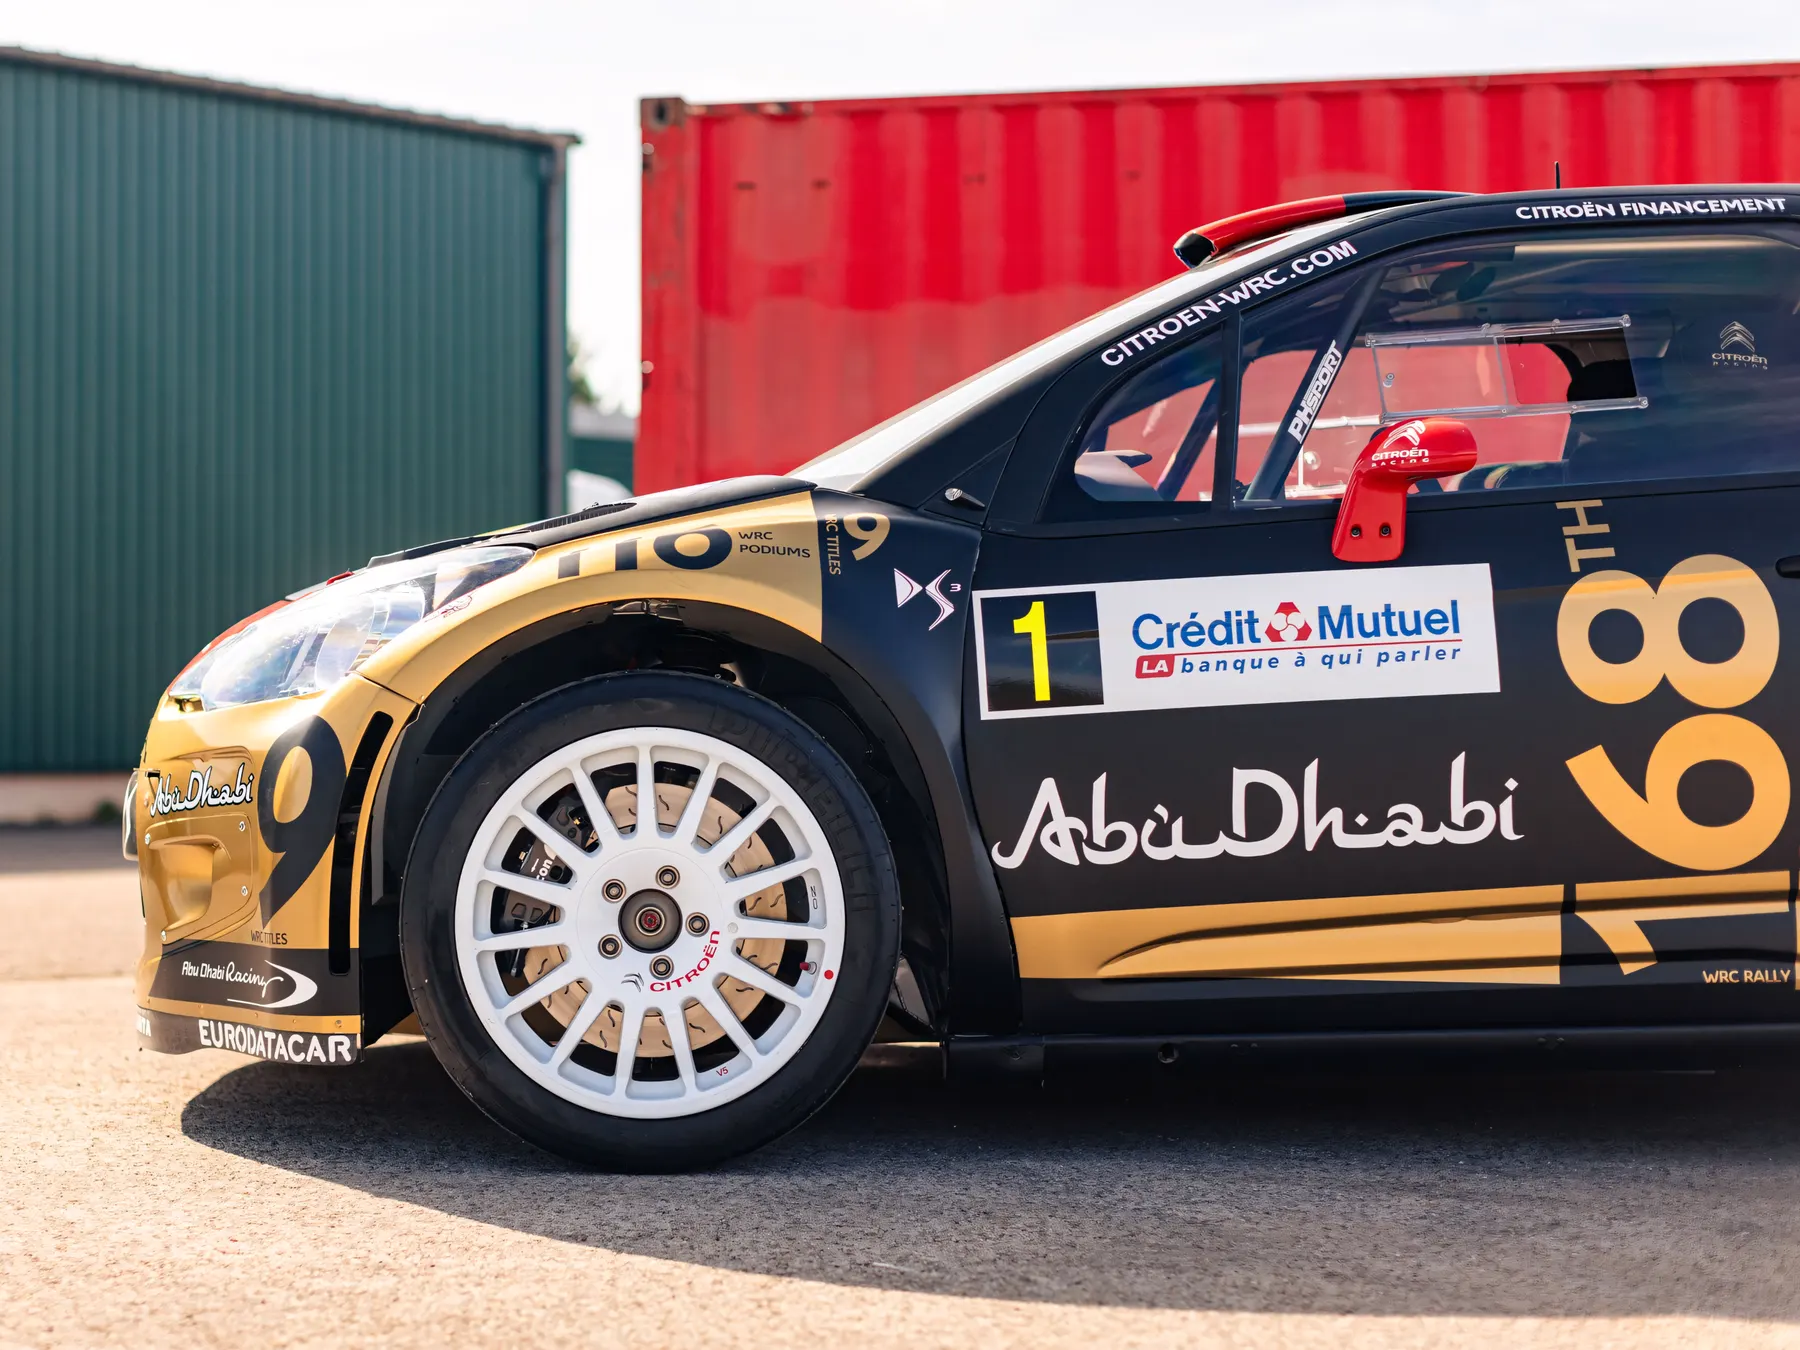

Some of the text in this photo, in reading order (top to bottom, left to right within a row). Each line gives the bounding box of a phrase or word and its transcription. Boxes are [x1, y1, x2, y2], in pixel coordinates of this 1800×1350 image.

[1516, 198, 1786, 220] CITROËN FINANCEMENT
[1101, 240, 1358, 366] CITROEN-WRC.COM
[1287, 339, 1342, 444] PHSPORT
[738, 531, 773, 540] WRC
[739, 544, 811, 558] PODIUMS
[843, 512, 891, 561] 9
[826, 535, 841, 575] TITLES
[1132, 600, 1460, 650] Crédit Mutuel
[1013, 601, 1051, 701] 1
[1141, 645, 1461, 674] LA banque à qui parler
[258, 714, 348, 929] 9
[250, 929, 288, 945] WRC TITLES
[181, 961, 284, 998] Abu Dhabi Racing
[1702, 969, 1791, 983] WRC RALLY
[198, 1018, 352, 1063] EURODATACAR
[716, 1066, 729, 1076] V5
